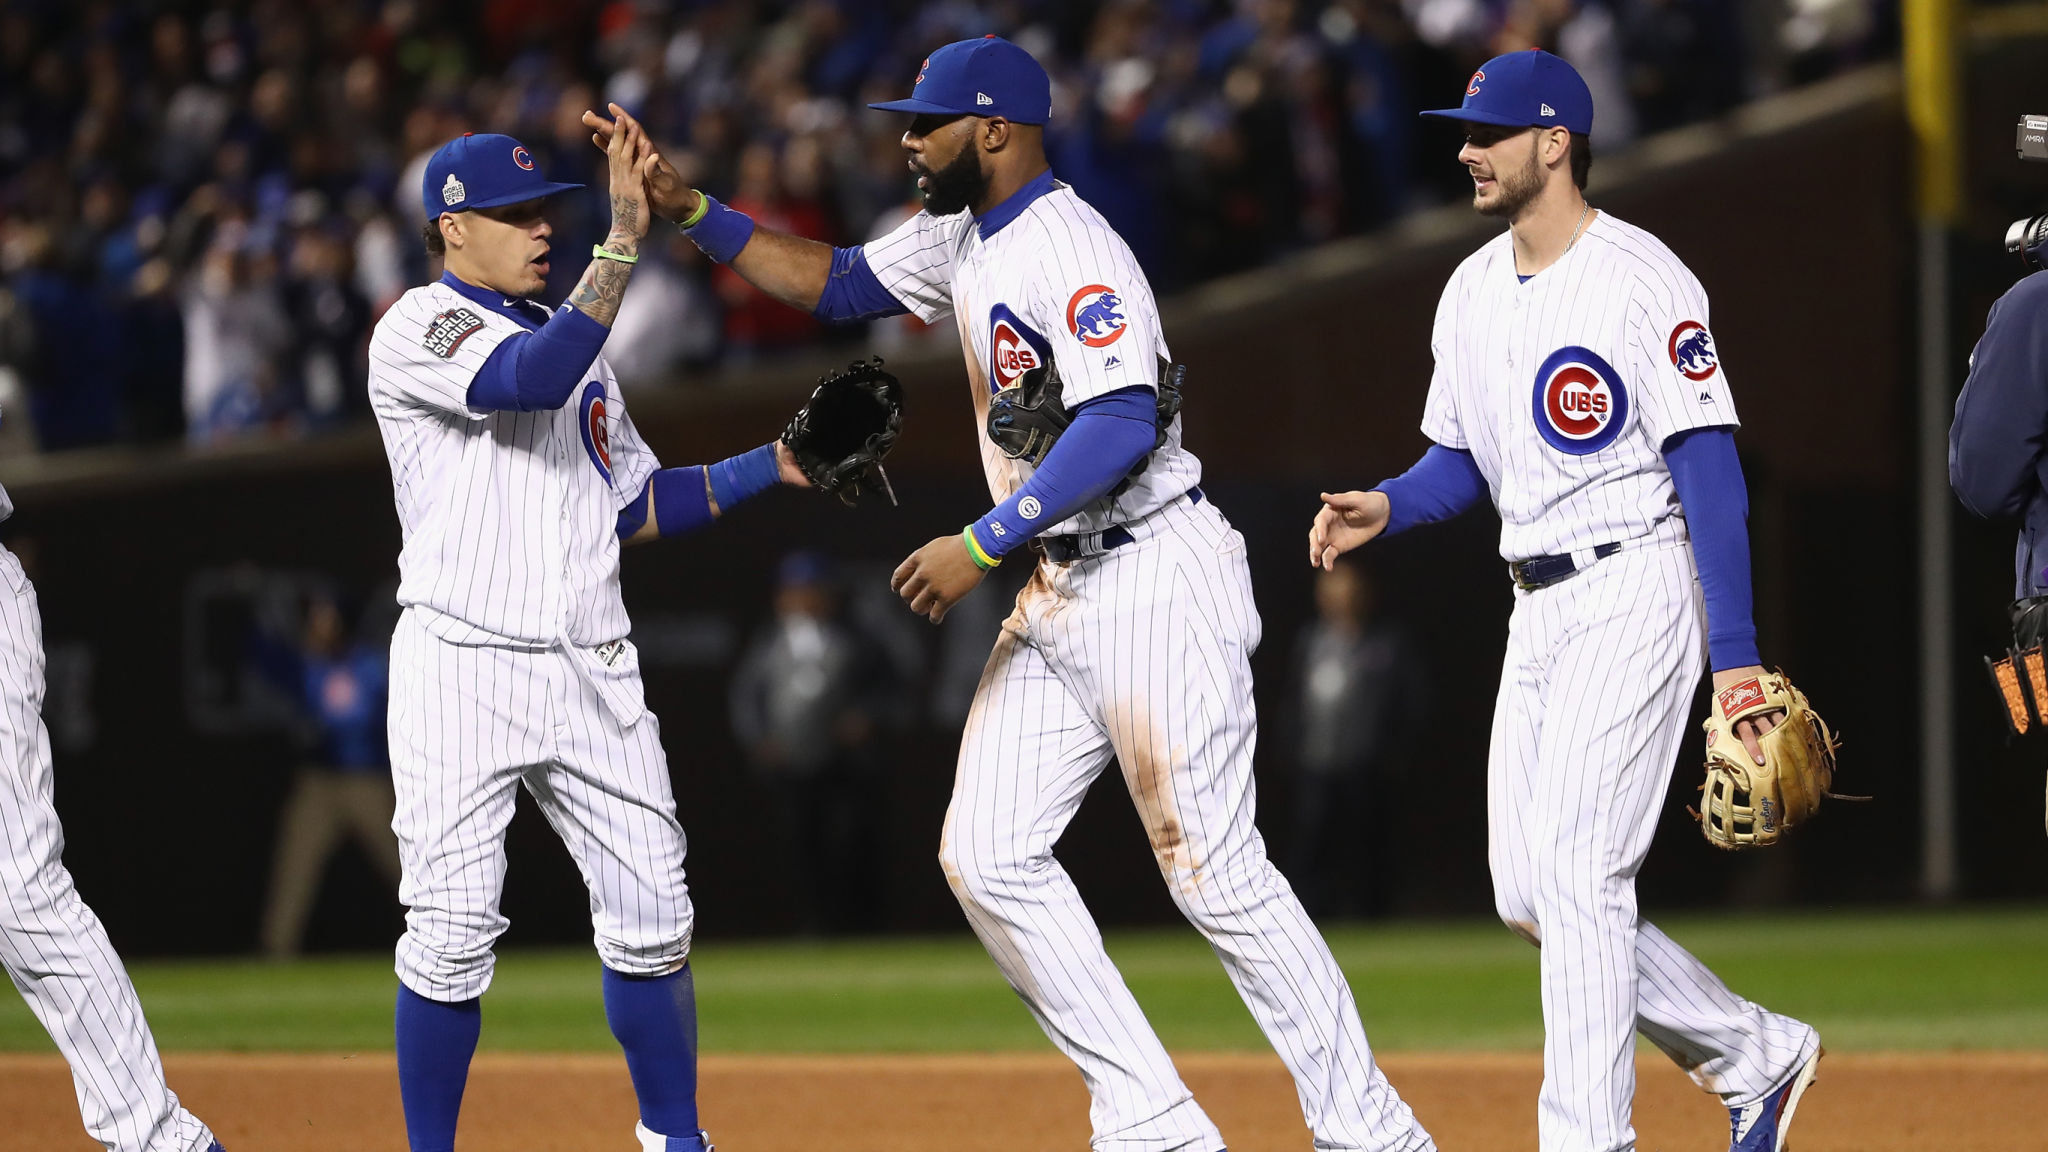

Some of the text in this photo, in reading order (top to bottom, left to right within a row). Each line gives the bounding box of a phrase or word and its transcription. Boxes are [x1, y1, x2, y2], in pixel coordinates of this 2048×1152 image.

[1466, 71, 1486, 97] C
[2024, 134, 2045, 144] AMIRA
[512, 146, 534, 171] C
[443, 184, 463, 195] WORLD
[445, 190, 465, 202] SERIES
[424, 310, 470, 349] WORLD
[433, 315, 481, 357] SERIES
[1547, 367, 1608, 436] CUBS
[990, 521, 1006, 537] 22
